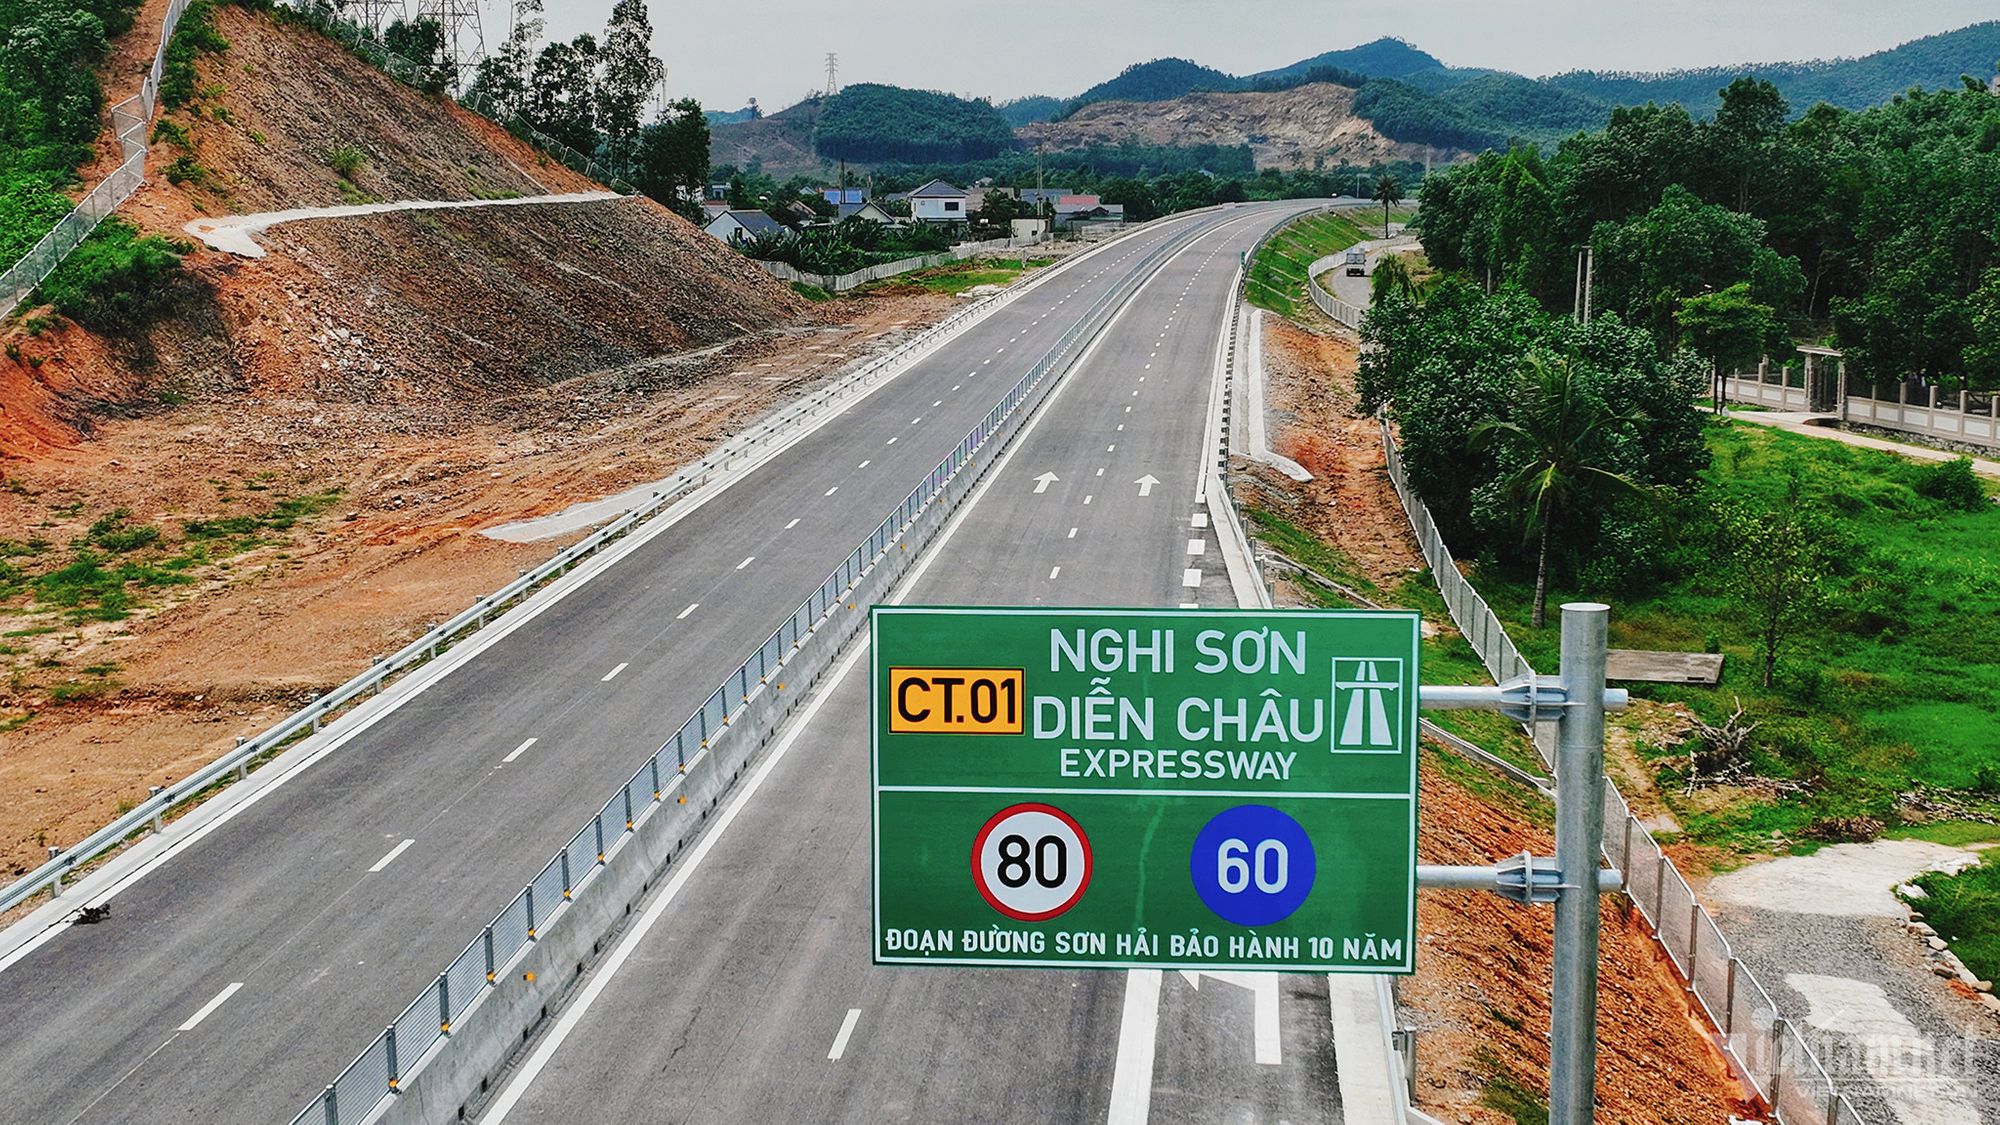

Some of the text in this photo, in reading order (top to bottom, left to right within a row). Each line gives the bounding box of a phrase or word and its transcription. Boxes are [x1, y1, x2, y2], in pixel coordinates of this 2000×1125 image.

[1050, 626, 1306, 675] NGHI SƠN
[897, 677, 1016, 724] CT.01
[1033, 677, 1323, 742] DIỄN CHÂU
[1060, 749, 1297, 780] EXPRESSWAY
[997, 834, 1067, 889] 80
[1217, 838, 1289, 894] 60
[885, 924, 1402, 960] ĐOẠN ĐƯỜNG SƠN HẢI BẢO HÀNH 10 NĂM
